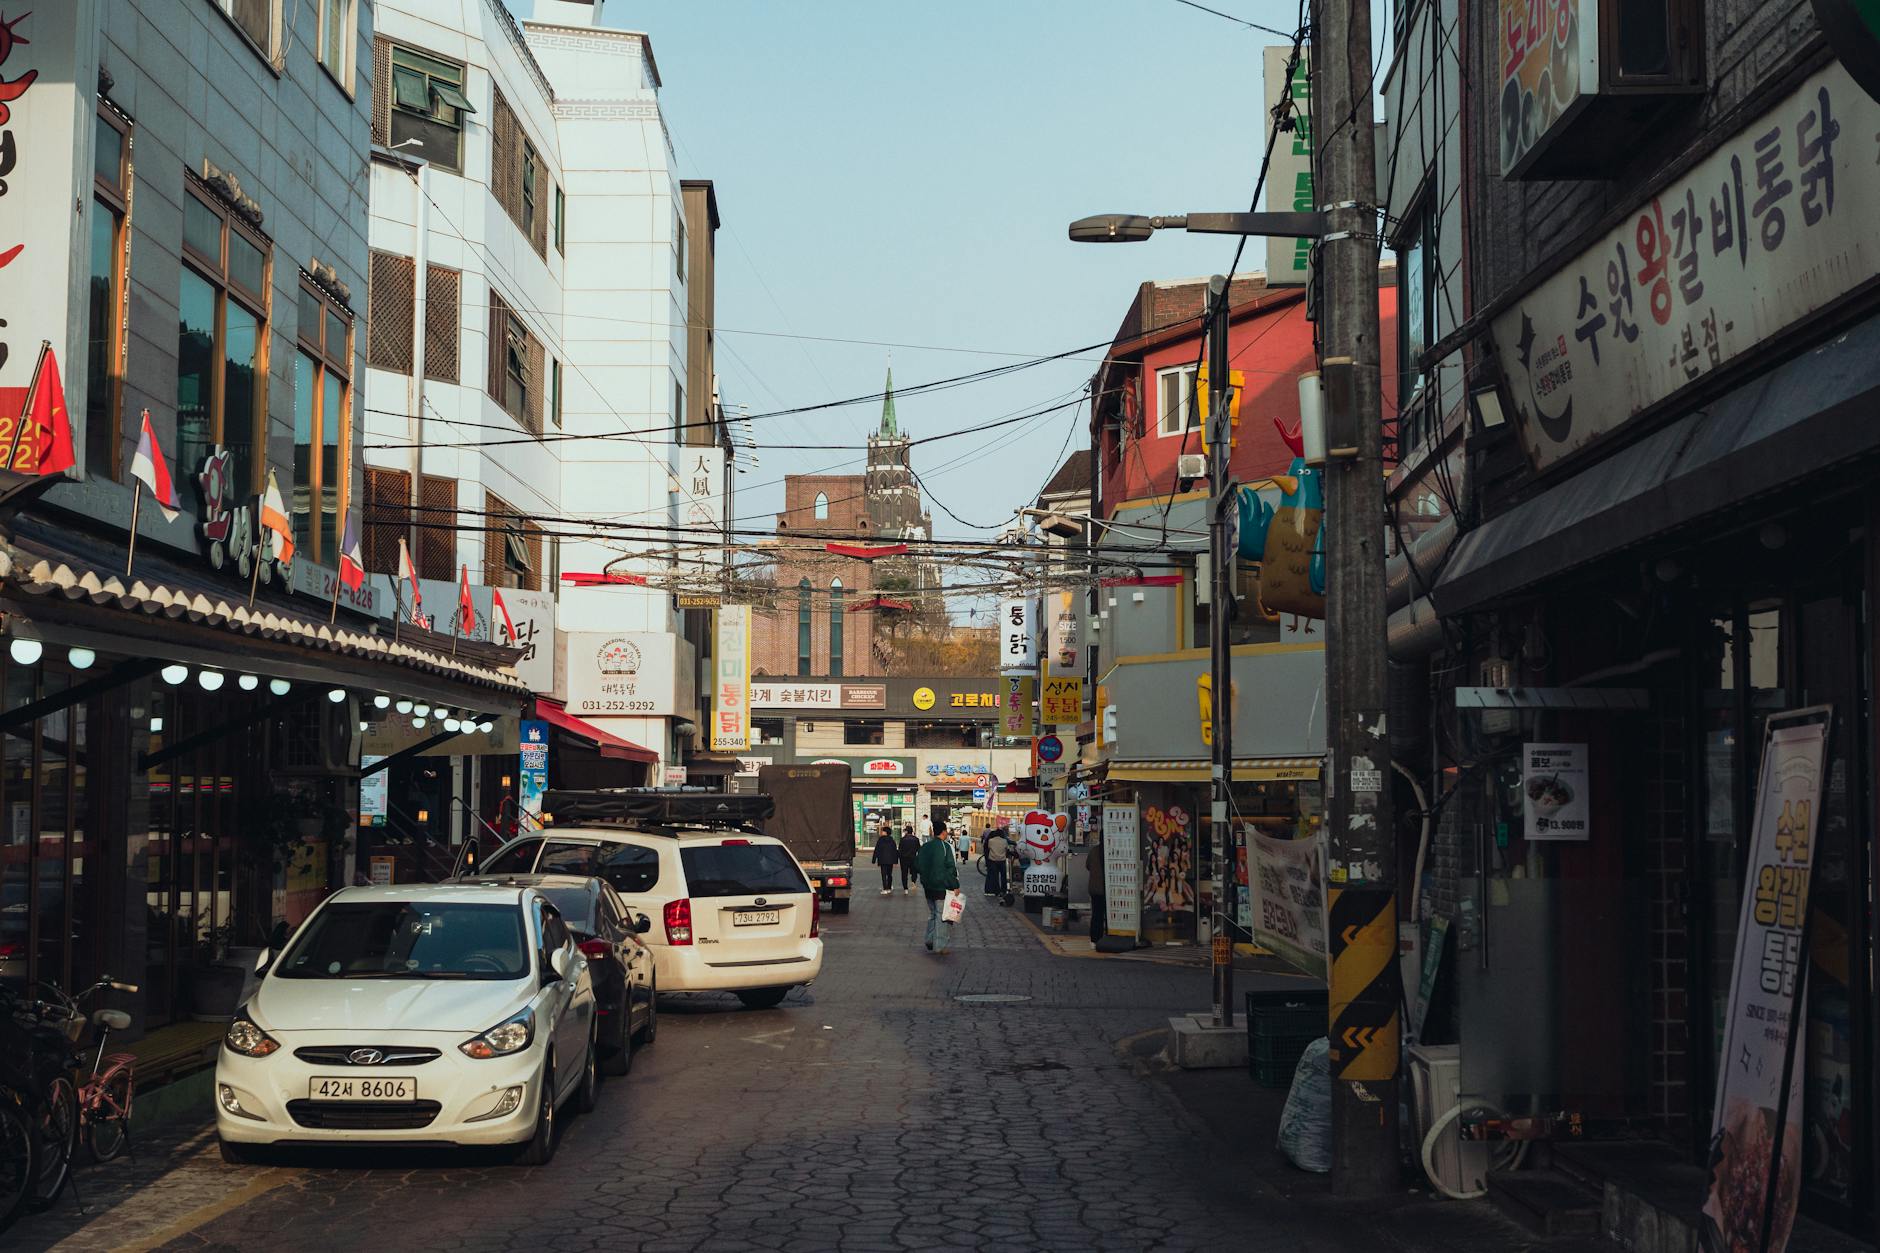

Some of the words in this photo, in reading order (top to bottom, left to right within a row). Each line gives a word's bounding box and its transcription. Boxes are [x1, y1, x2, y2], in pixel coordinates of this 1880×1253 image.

[1059, 613, 1076, 621] MEGA
[1059, 621, 1077, 631] SIZE
[1045, 682, 1078, 696] 성지
[780, 689, 832, 703] 숯불치킨
[582, 701, 655, 711] 031-252-9292
[1046, 698, 1079, 713] 통닭
[713, 737, 747, 746] 255-3401
[1775, 799, 1811, 864] 수원
[1026, 874, 1057, 883] 포장할인
[756, 912, 775, 922] 2792
[319, 1081, 353, 1097] 42서
[361, 1081, 406, 1097] 8606
